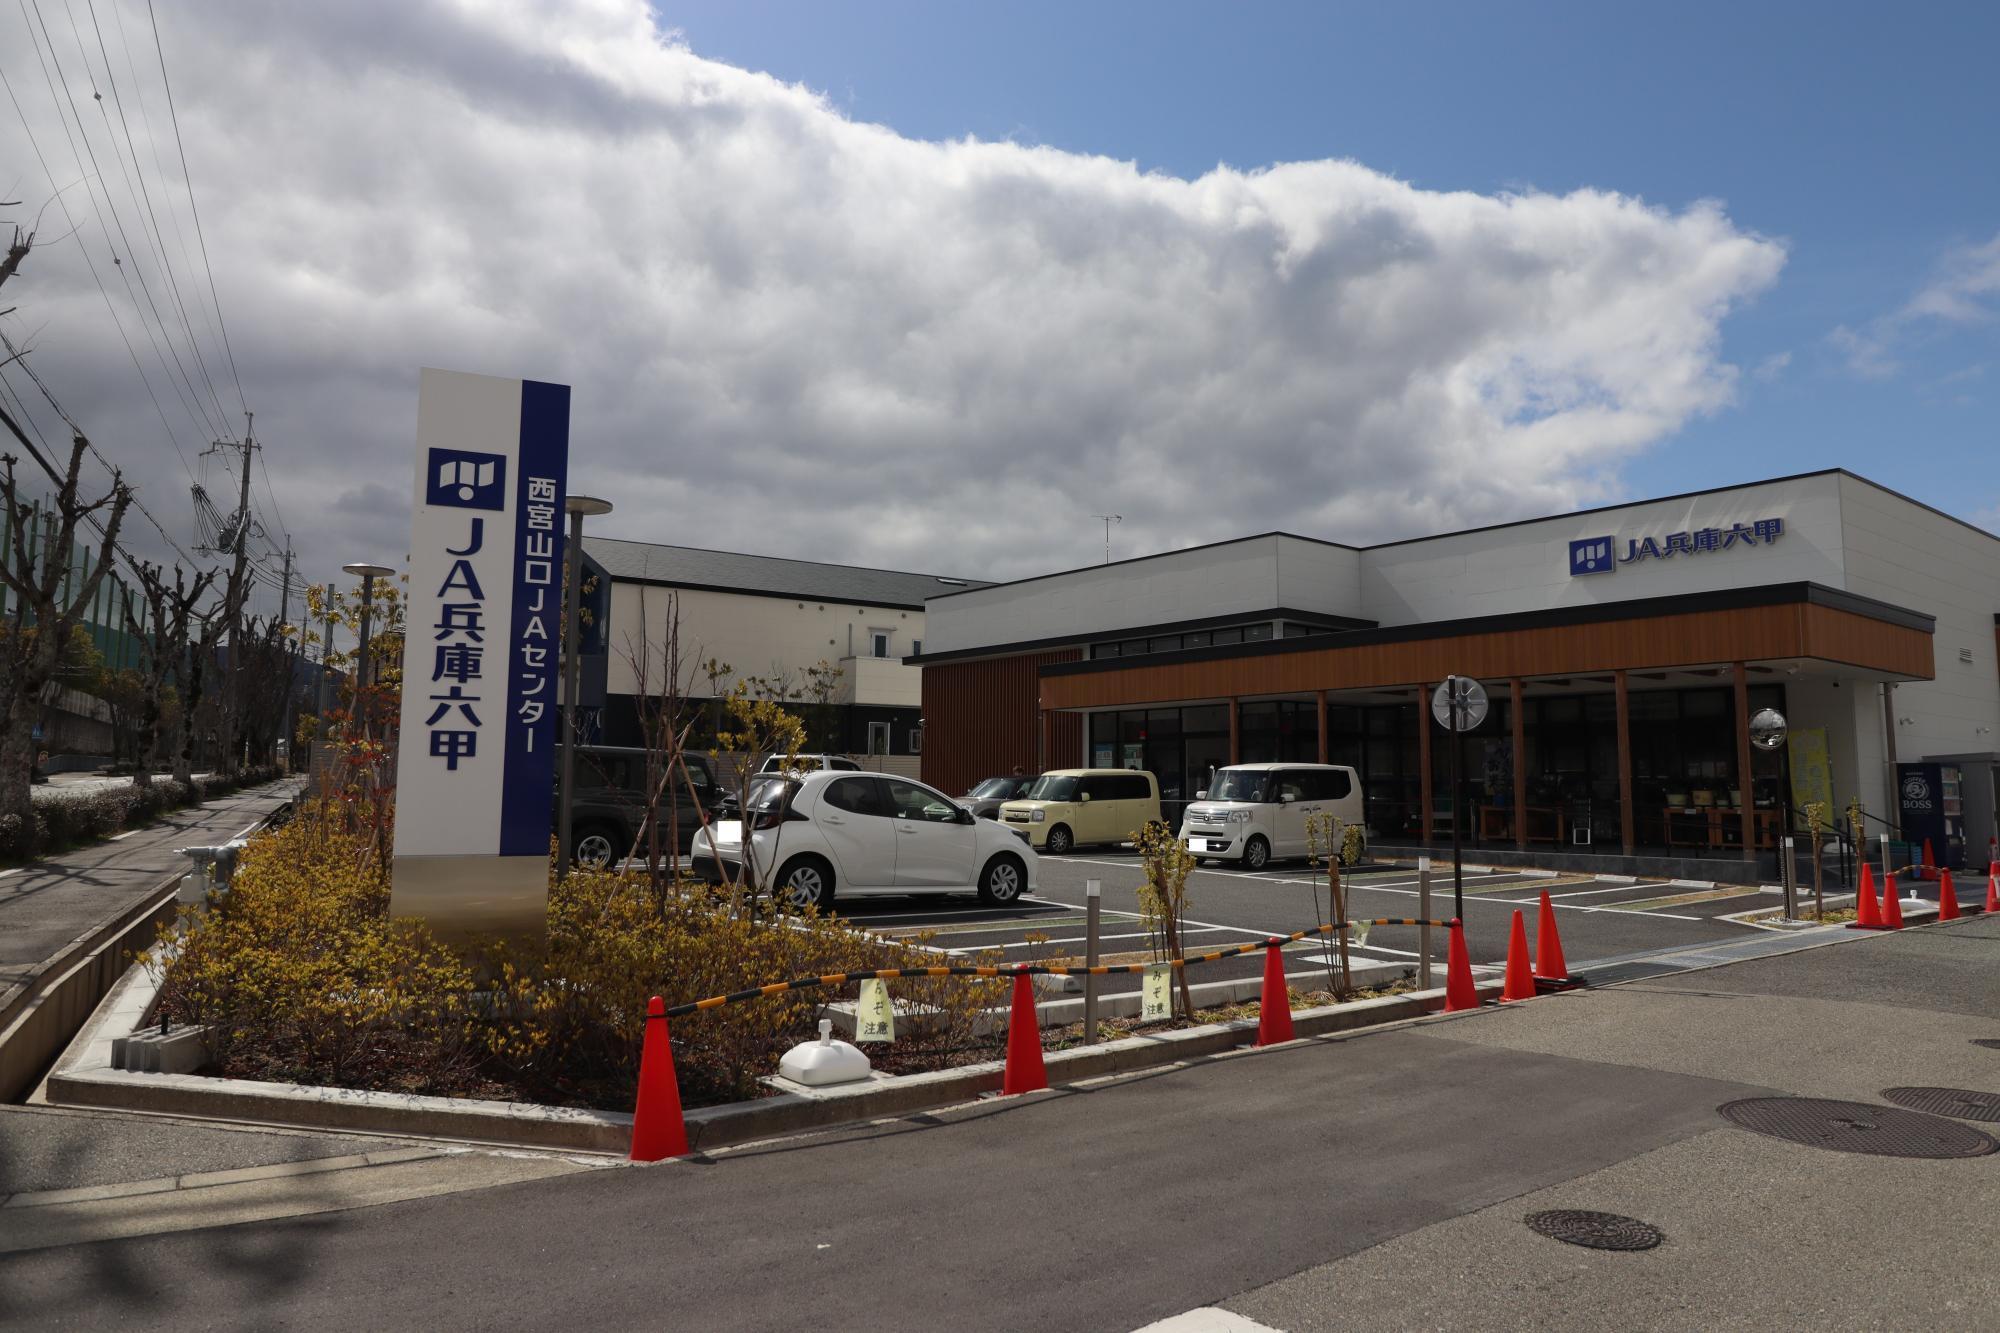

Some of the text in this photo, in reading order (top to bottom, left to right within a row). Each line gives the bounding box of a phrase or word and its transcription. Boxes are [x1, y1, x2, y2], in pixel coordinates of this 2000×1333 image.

[1618, 518, 1784, 563] JA兵庫六甲
[518, 476, 556, 753] 西宮山口JAセンター
[425, 518, 485, 771] JA兵庫六甲
[1903, 800, 1932, 809] BOSS
[1146, 1002, 1164, 1014] 注意
[864, 1021, 888, 1035] 注意
